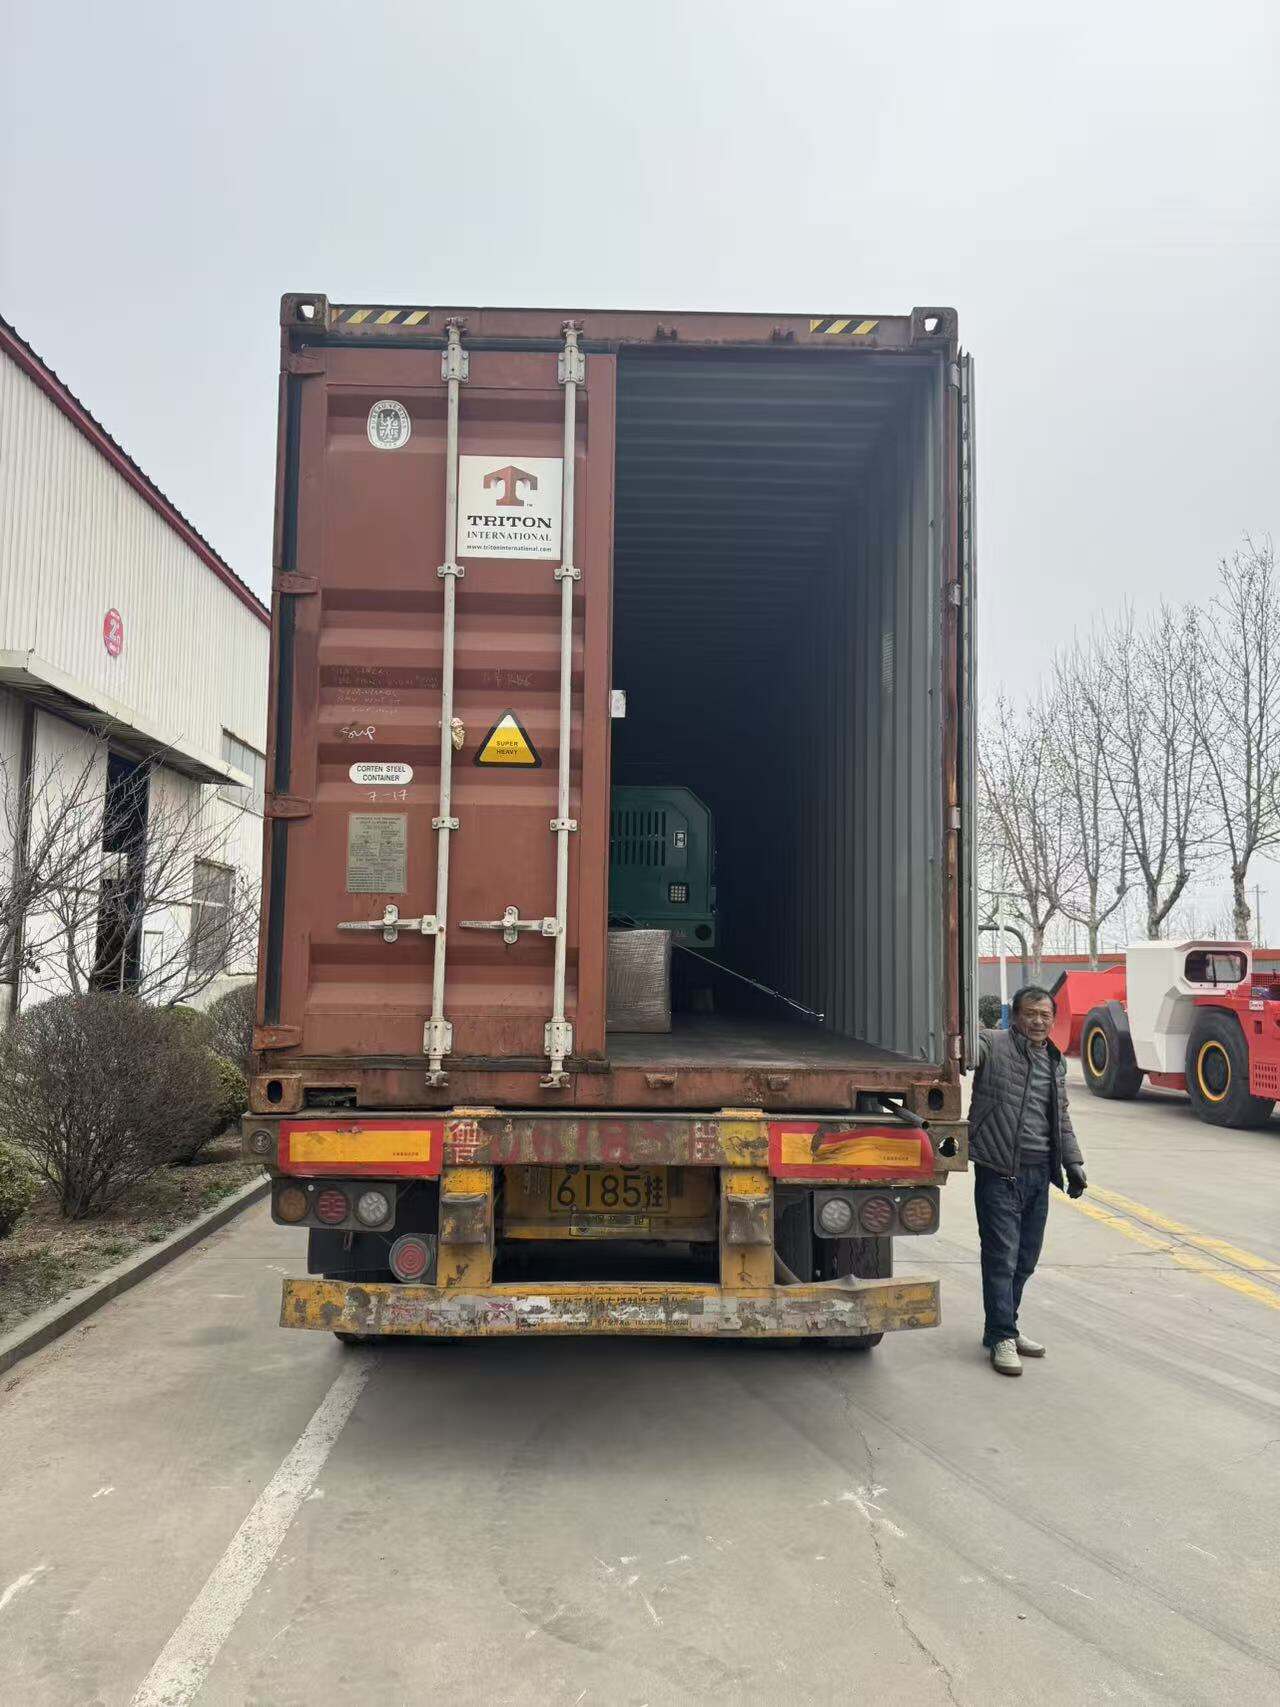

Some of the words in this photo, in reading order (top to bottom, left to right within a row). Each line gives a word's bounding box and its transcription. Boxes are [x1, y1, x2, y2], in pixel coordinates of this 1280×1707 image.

[467, 515, 552, 528] TRITON
[467, 531, 552, 541] INTERNATIONAL
[356, 765, 383, 773] CORTEN
[386, 765, 407, 773] STEEL
[556, 1173, 664, 1208] 6185挂
